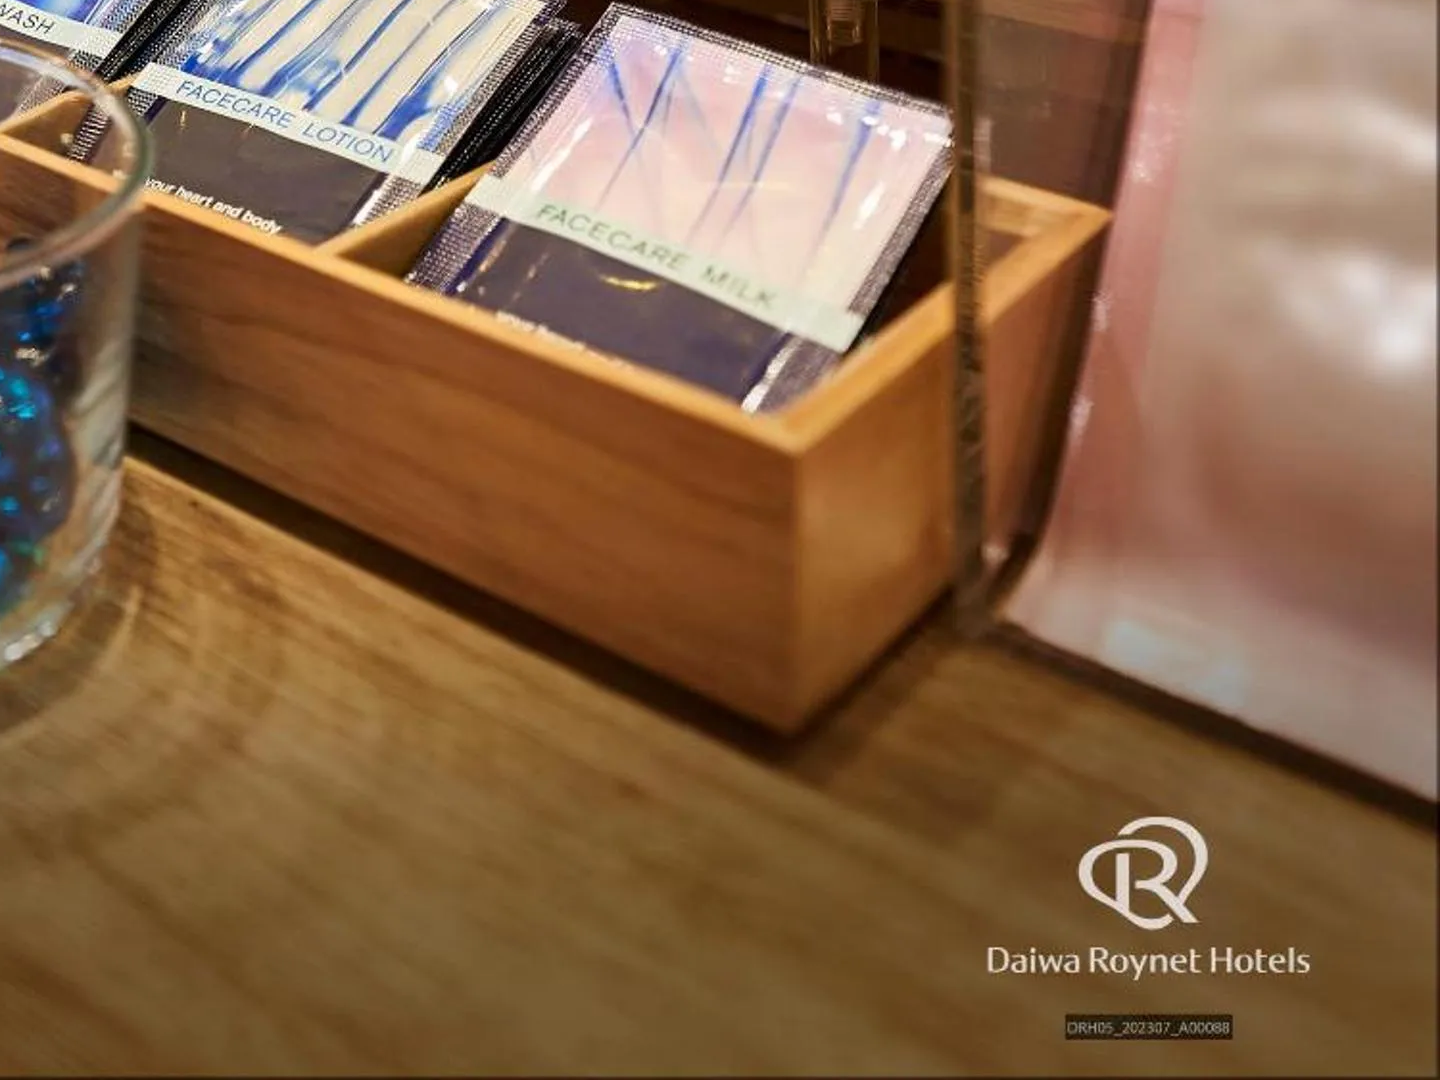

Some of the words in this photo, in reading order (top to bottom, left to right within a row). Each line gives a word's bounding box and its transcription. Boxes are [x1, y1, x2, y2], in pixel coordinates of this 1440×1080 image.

[176, 80, 296, 129] FACECARE
[302, 122, 393, 163] LOTION
[145, 176, 177, 195] your
[175, 185, 214, 208] heart
[213, 201, 244, 219] and
[241, 210, 283, 235] body
[538, 204, 690, 270] FACECARE
[702, 264, 779, 309] MILK
